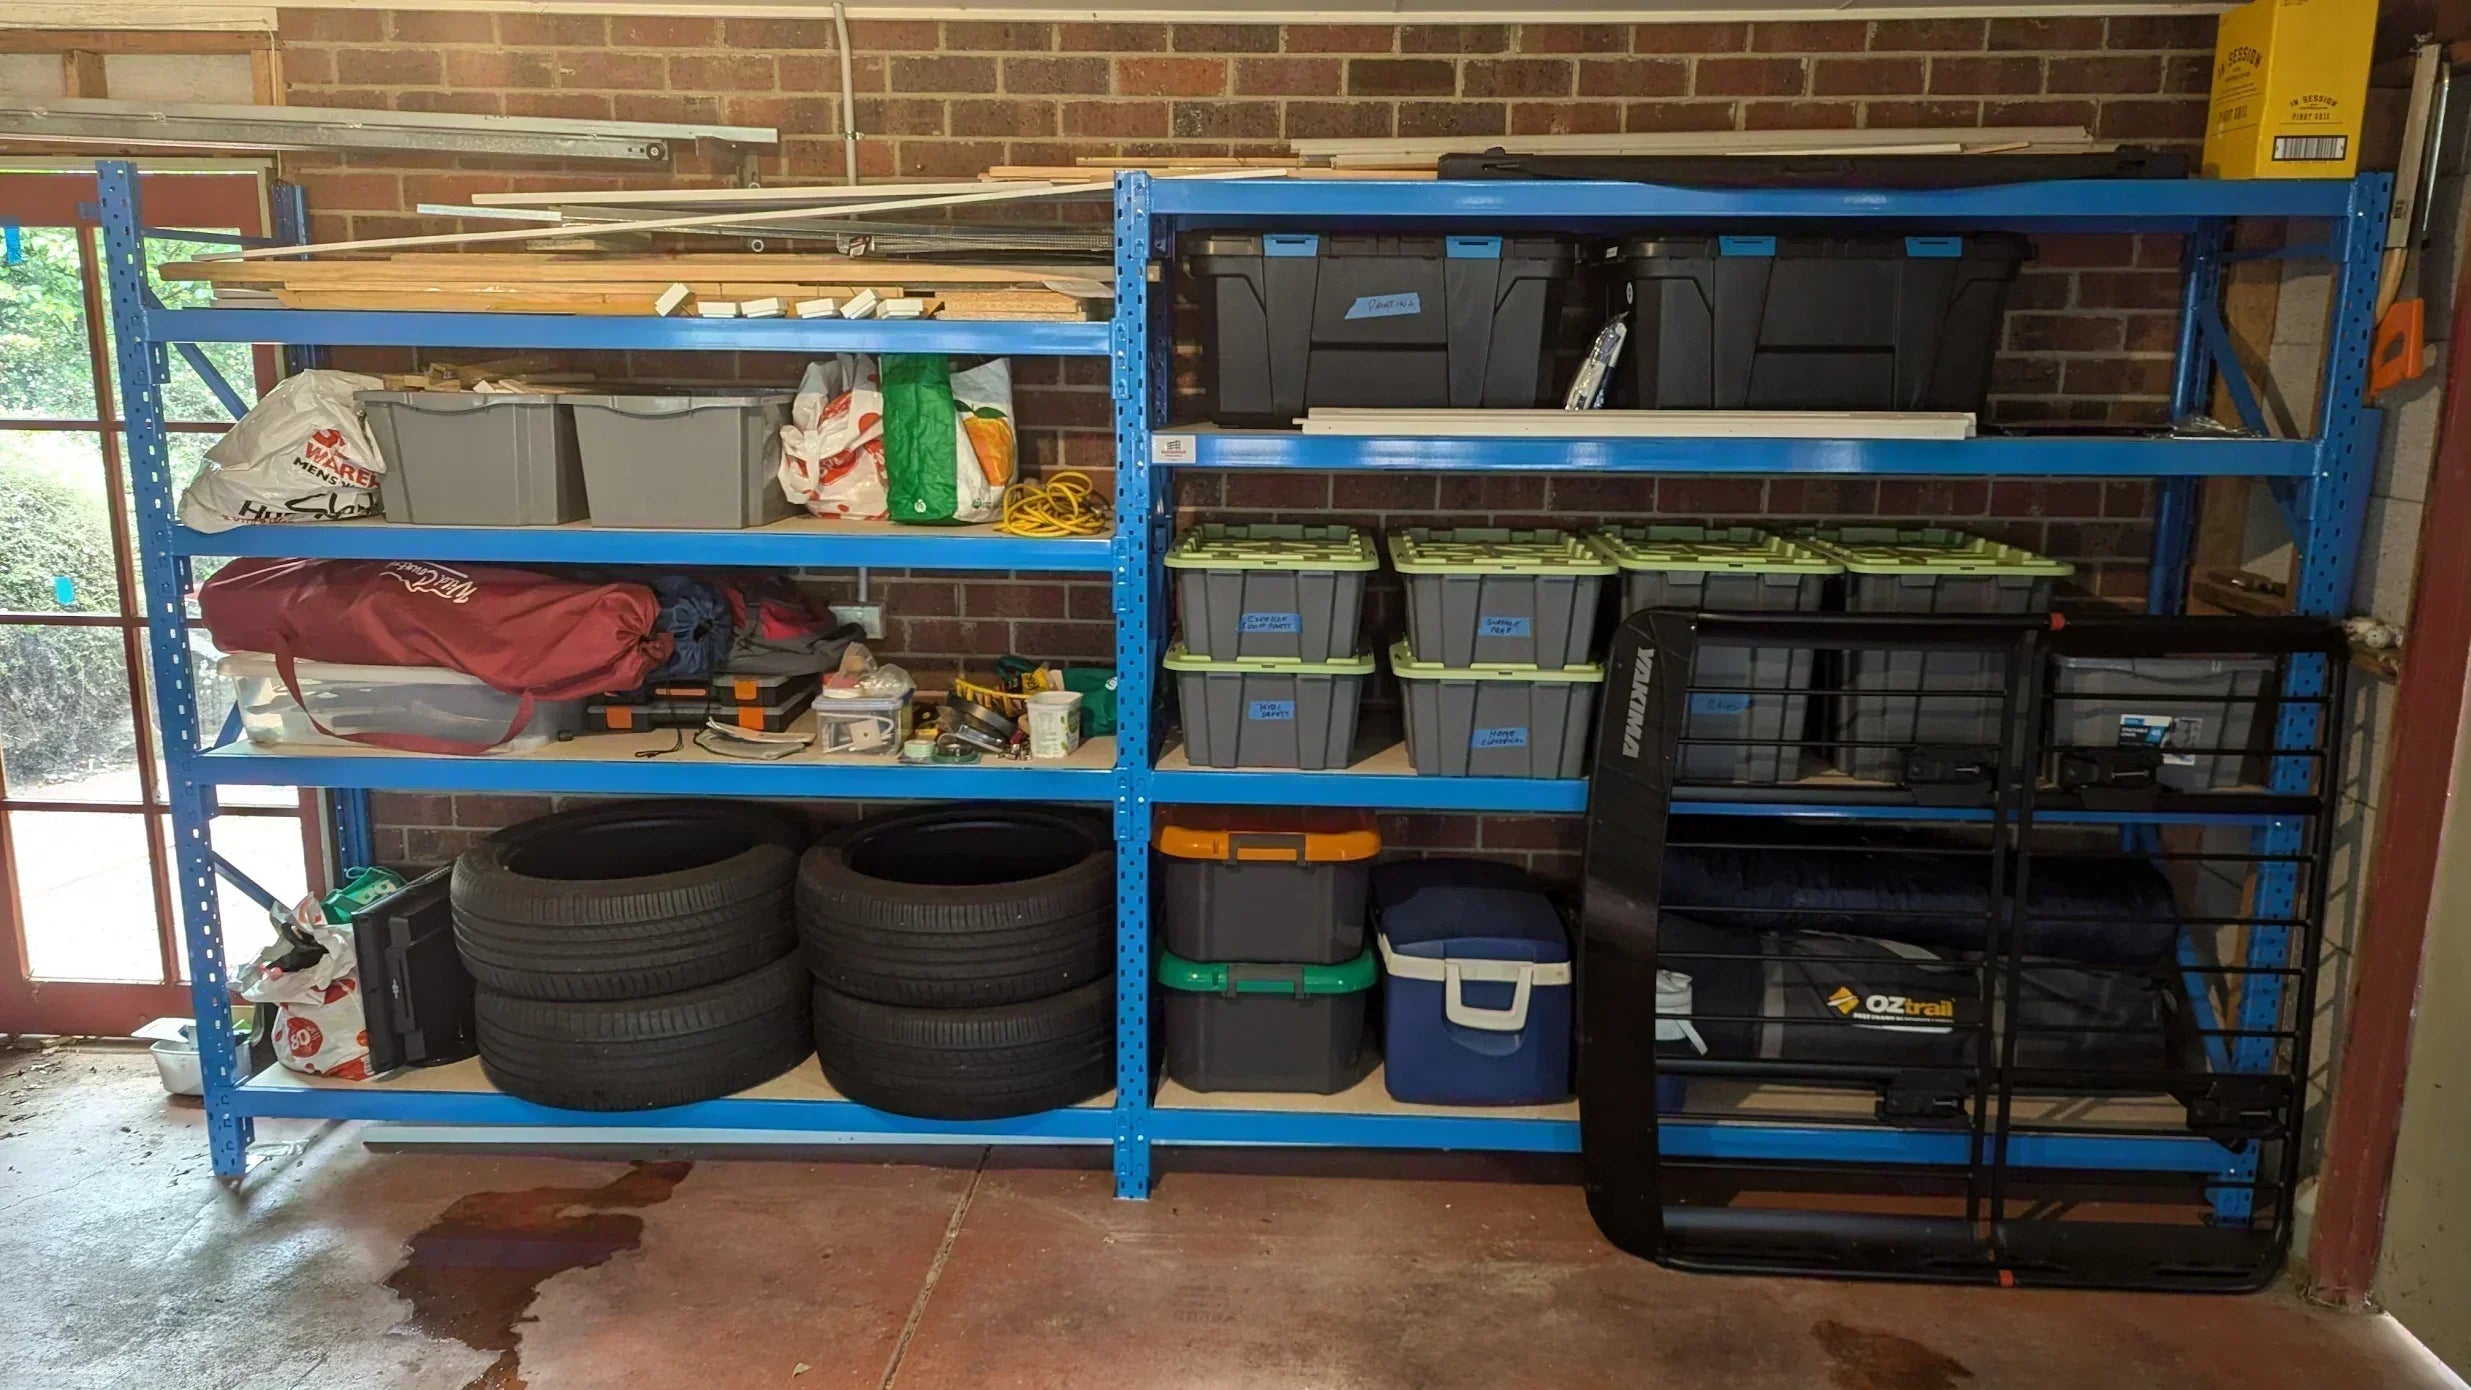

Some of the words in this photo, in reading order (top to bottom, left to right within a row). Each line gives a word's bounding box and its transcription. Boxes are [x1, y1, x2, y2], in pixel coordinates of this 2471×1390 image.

[2228, 46, 2262, 69] SESSION
[2289, 98, 2299, 108] IN
[2302, 94, 2338, 107] SESSION
[2292, 112, 2312, 121] PINOT
[293, 456, 338, 486] MENS
[433, 573, 478, 604] Wild
[1622, 646, 1655, 759] YAKIMA
[1865, 994, 1953, 1017] OZtrail
[290, 1028, 311, 1051] 80
